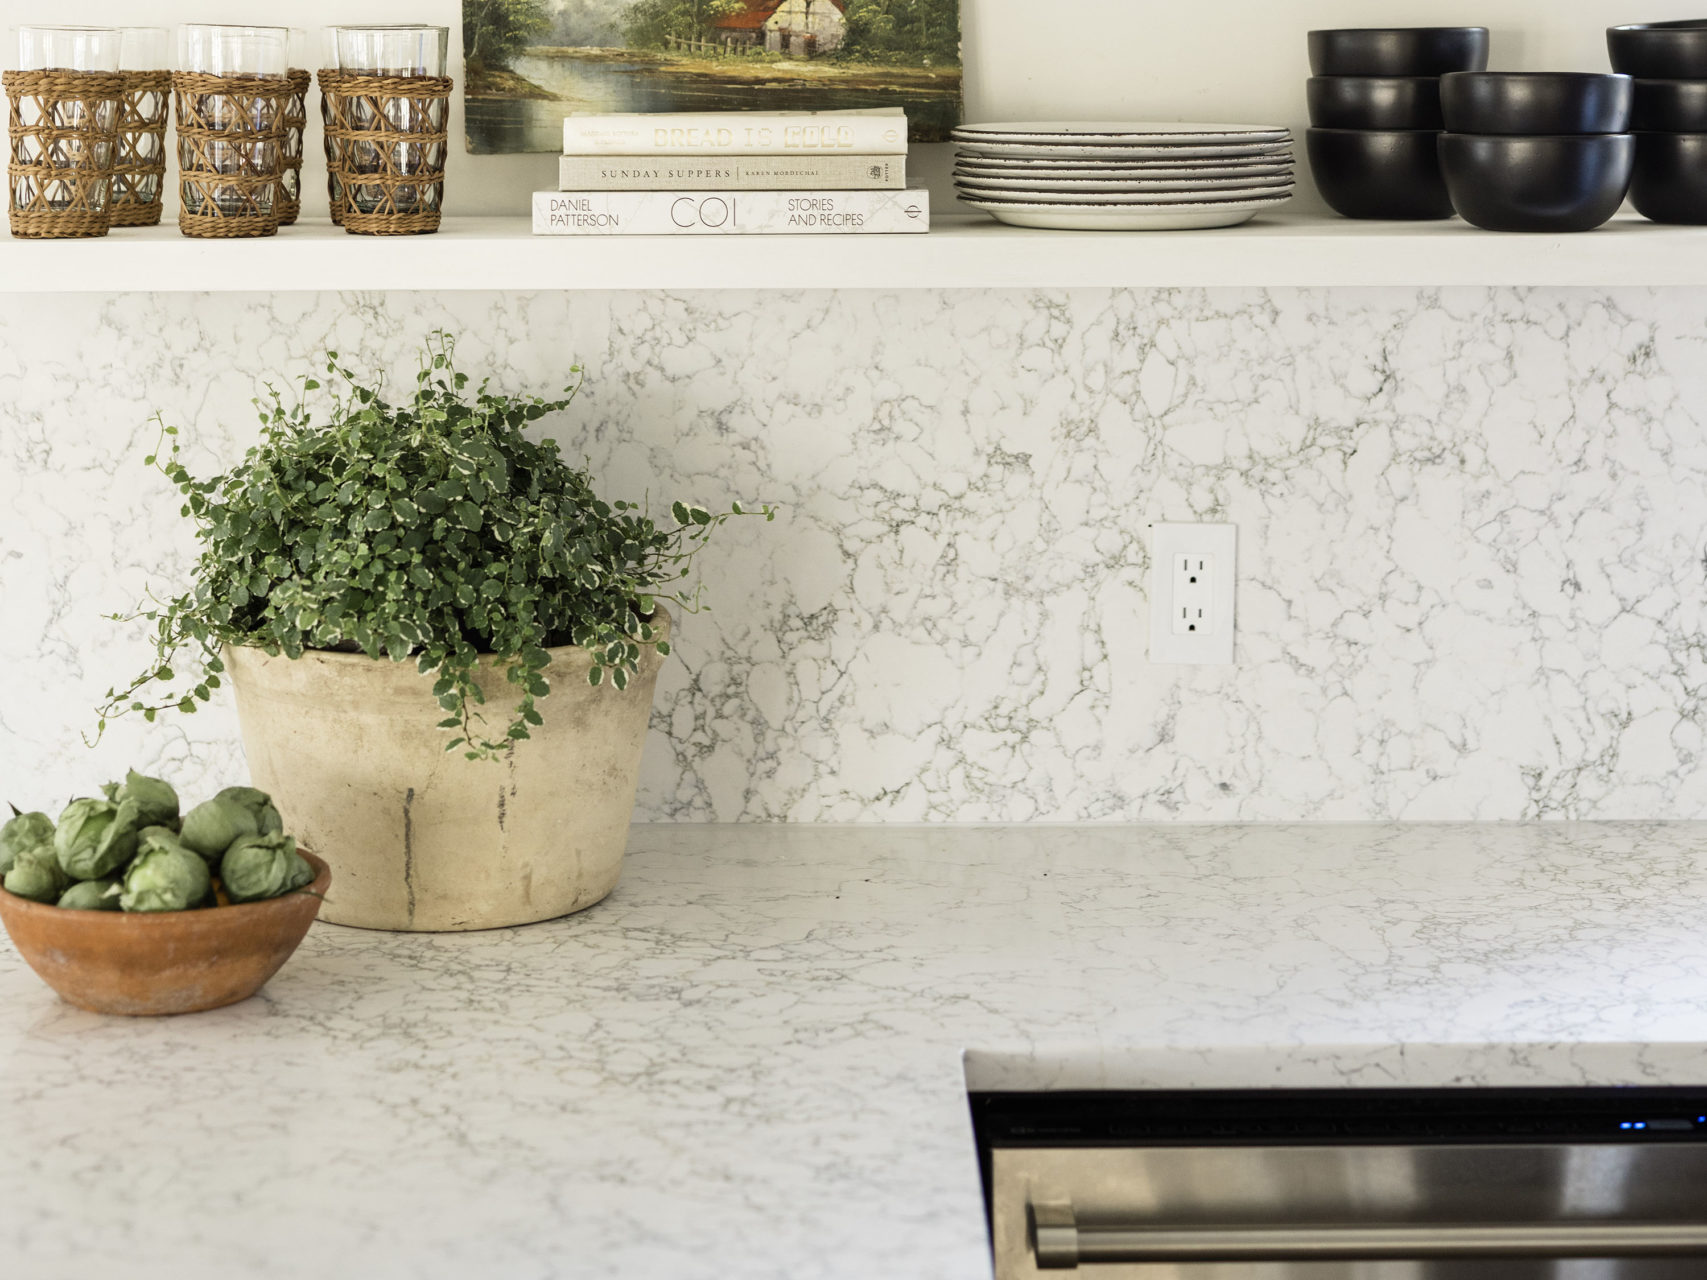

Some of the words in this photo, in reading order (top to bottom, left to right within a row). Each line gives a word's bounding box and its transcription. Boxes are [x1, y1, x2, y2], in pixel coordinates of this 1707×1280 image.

[654, 127, 733, 147] BREAD
[743, 127, 772, 147] IS
[601, 169, 660, 178] SUNDAY
[668, 169, 731, 178] SUPPERS
[550, 199, 592, 212] DANIEL
[670, 197, 736, 227] COI
[788, 198, 834, 212] STORIES
[550, 213, 619, 227] PATTERSON
[787, 213, 817, 226] AND
[820, 213, 864, 226] RECIPES
